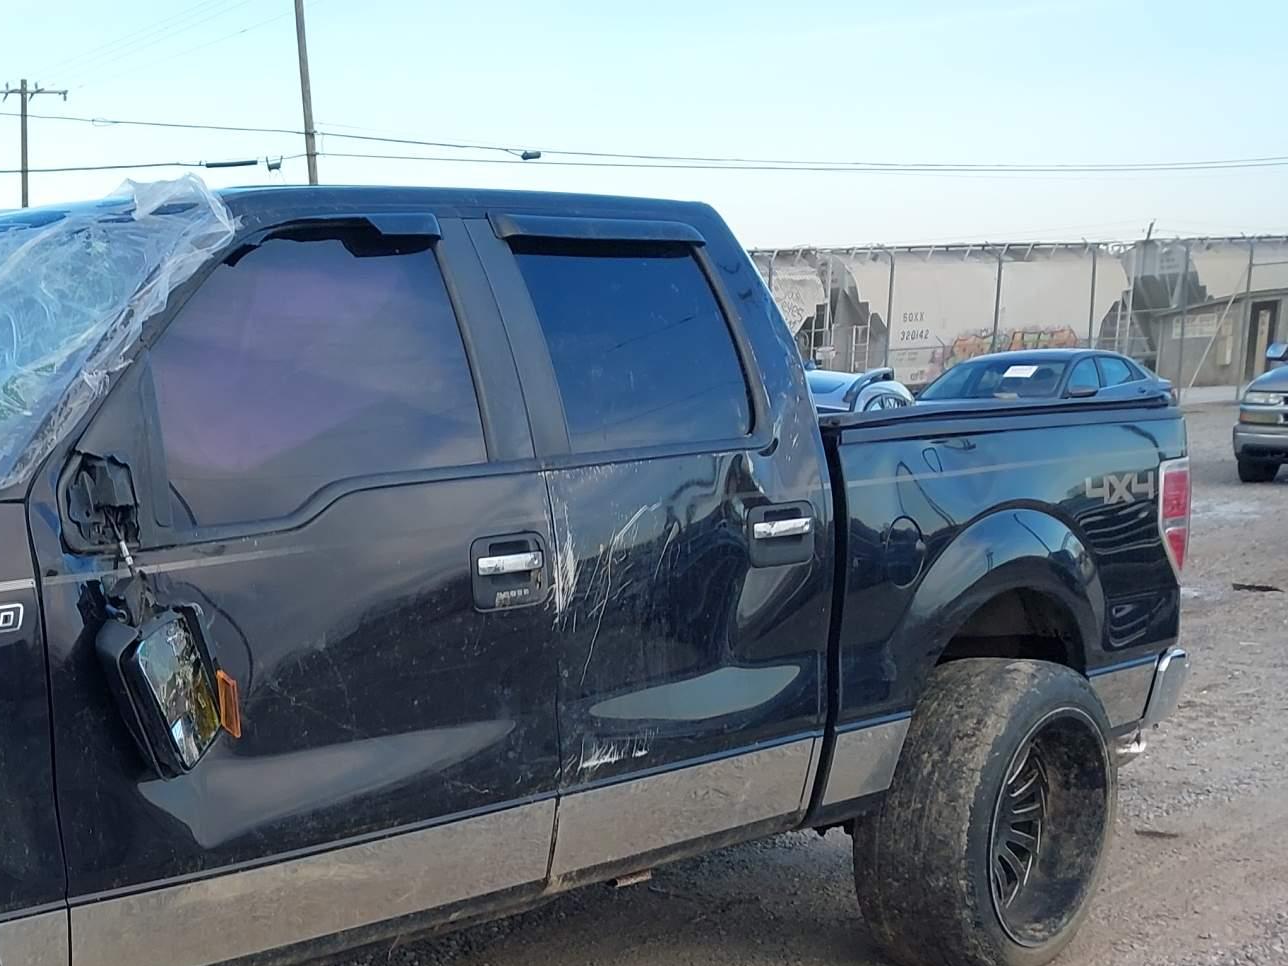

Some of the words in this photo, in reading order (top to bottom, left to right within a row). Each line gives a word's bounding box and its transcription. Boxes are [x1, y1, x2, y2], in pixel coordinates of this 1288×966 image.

[903, 312, 925, 322] SOXX
[900, 328, 930, 341] 320142
[1085, 470, 1155, 504] 4X4
